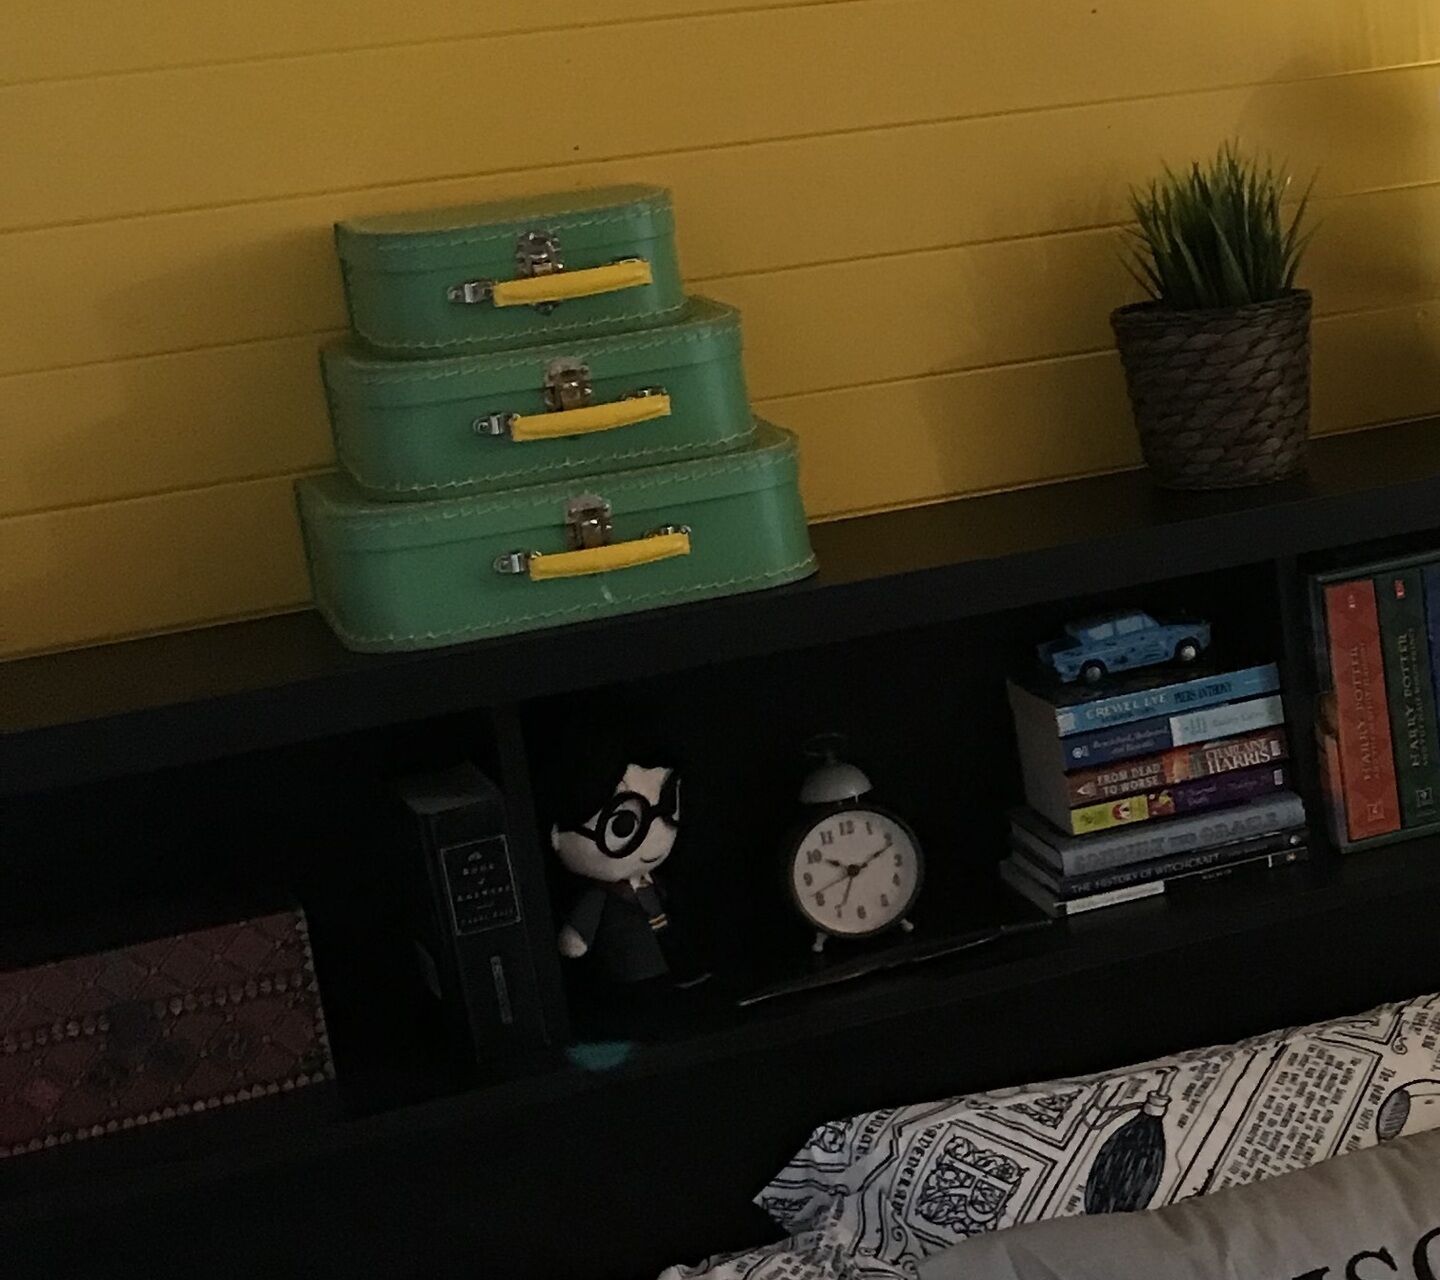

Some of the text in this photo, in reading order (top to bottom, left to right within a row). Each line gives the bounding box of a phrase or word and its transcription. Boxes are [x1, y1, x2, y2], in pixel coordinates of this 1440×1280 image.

[1398, 634, 1413, 696] POTTER
[1406, 706, 1420, 767] HARRY
[1207, 751, 1272, 775] HARRIS
[1097, 763, 1161, 786] FROM DEAD
[1104, 774, 1160, 797] TO WORSE
[839, 821, 855, 835] 12
[820, 831, 834, 845] 11
[806, 849, 823, 864] 10
[894, 855, 903, 867] 3
[1071, 882, 1094, 896] THE
